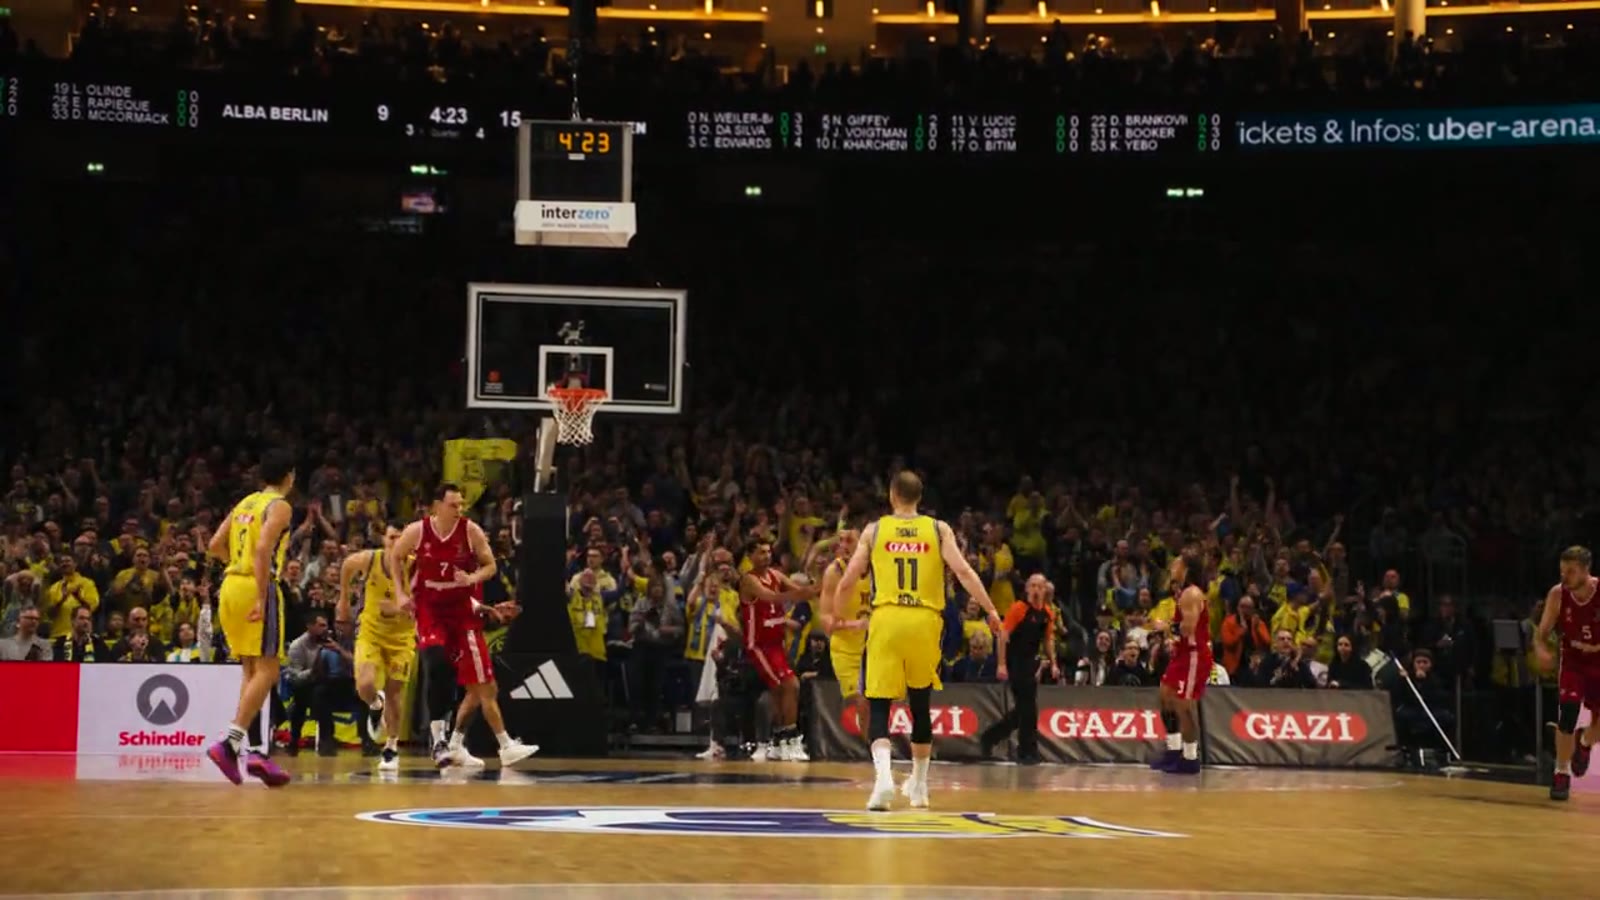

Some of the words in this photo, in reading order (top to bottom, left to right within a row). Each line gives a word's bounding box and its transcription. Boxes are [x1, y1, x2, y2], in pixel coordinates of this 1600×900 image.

[54, 82, 69, 95] 19
[86, 84, 132, 98] OLINDE
[190, 91, 199, 102] 0
[8, 104, 17, 116] 0
[52, 96, 69, 108] 25
[190, 104, 199, 115] 0
[52, 109, 69, 120] 33
[88, 109, 169, 125] MCCORMACK
[189, 115, 198, 127] 0
[222, 104, 267, 120] ALBA
[270, 106, 328, 122] BERLIN
[377, 105, 389, 121] 9
[429, 107, 468, 124] 4:23
[500, 111, 522, 127] 15
[688, 112, 697, 124] 0
[1211, 114, 1220, 125] 0
[847, 115, 890, 126] GIFFEY
[952, 115, 964, 126] 11
[983, 115, 1016, 127] LUCIC
[1070, 115, 1079, 127] 0
[405, 124, 414, 136] 3
[475, 127, 485, 139] 4
[715, 124, 732, 135] DA
[734, 124, 766, 136] SILVA
[952, 127, 965, 139] 13
[983, 127, 1016, 139] OBST
[1070, 127, 1079, 139] 0
[1091, 127, 1105, 139] 31
[1125, 127, 1175, 139] BOOKER
[1236, 120, 1317, 145] ickets
[1323, 119, 1343, 145] &
[1350, 118, 1421, 143] Infos:
[1427, 116, 1600, 141] uber-arena.
[688, 136, 697, 148] 3
[714, 137, 772, 149] EDWARDS
[816, 137, 830, 149] 10
[928, 139, 937, 150] 0
[952, 139, 965, 151] 17
[985, 140, 1016, 151] BITIM
[1070, 140, 1079, 152] 0
[1091, 139, 1106, 151] 53
[1125, 139, 1158, 151] YEBO
[1211, 139, 1220, 151] 0
[541, 204, 610, 219] interzero
[440, 562, 449, 577] 7
[894, 558, 918, 591] 11
[770, 603, 776, 614] 1
[1581, 625, 1592, 640] 5
[119, 730, 205, 746] Schindler
